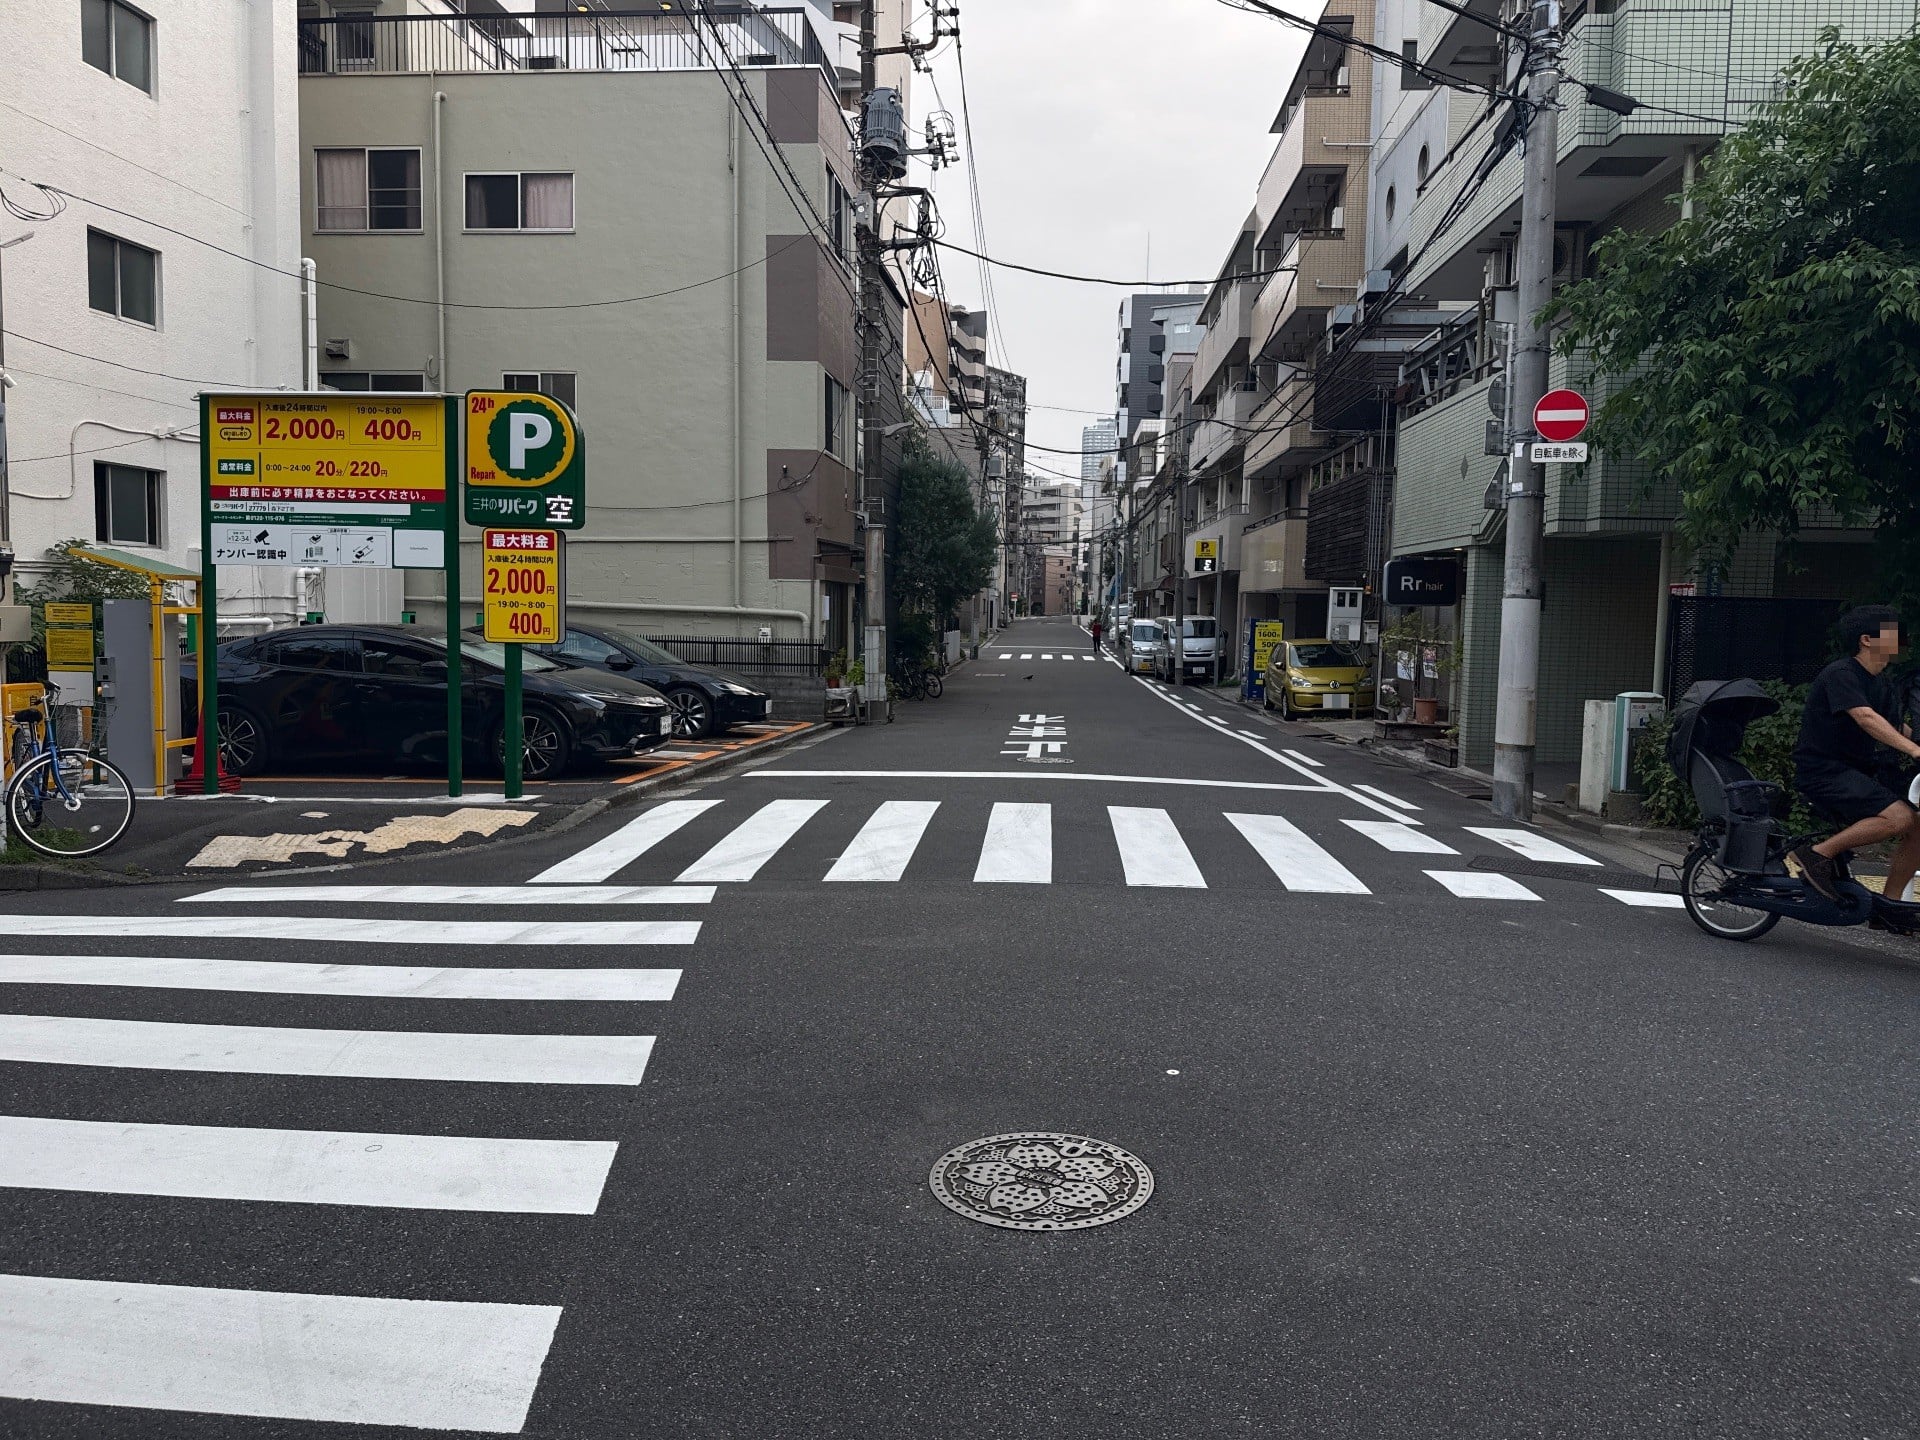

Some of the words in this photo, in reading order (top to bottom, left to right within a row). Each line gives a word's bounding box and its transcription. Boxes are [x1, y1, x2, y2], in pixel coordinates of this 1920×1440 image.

[471, 397, 495, 413] 24h
[219, 411, 252, 421] 最大料金
[265, 417, 345, 440] 2,000円
[364, 419, 422, 441] 400円
[510, 412, 552, 470] P
[1534, 447, 1584, 459] 自転車を除く
[220, 462, 252, 472] 通常料金
[470, 467, 496, 481] Repark
[229, 486, 426, 501] 出庫前に必ず精算をおこなってください。
[546, 495, 573, 523] 空
[492, 534, 549, 549] 最大料金
[216, 548, 287, 560] ナンバー認識中
[488, 554, 554, 564] 入庫後24時間以内
[487, 568, 555, 595] 2,000円
[1401, 575, 1423, 591] Rr
[1425, 581, 1444, 591] hair
[509, 612, 551, 635] 400円
[1000, 714, 1068, 758] 止まれ
